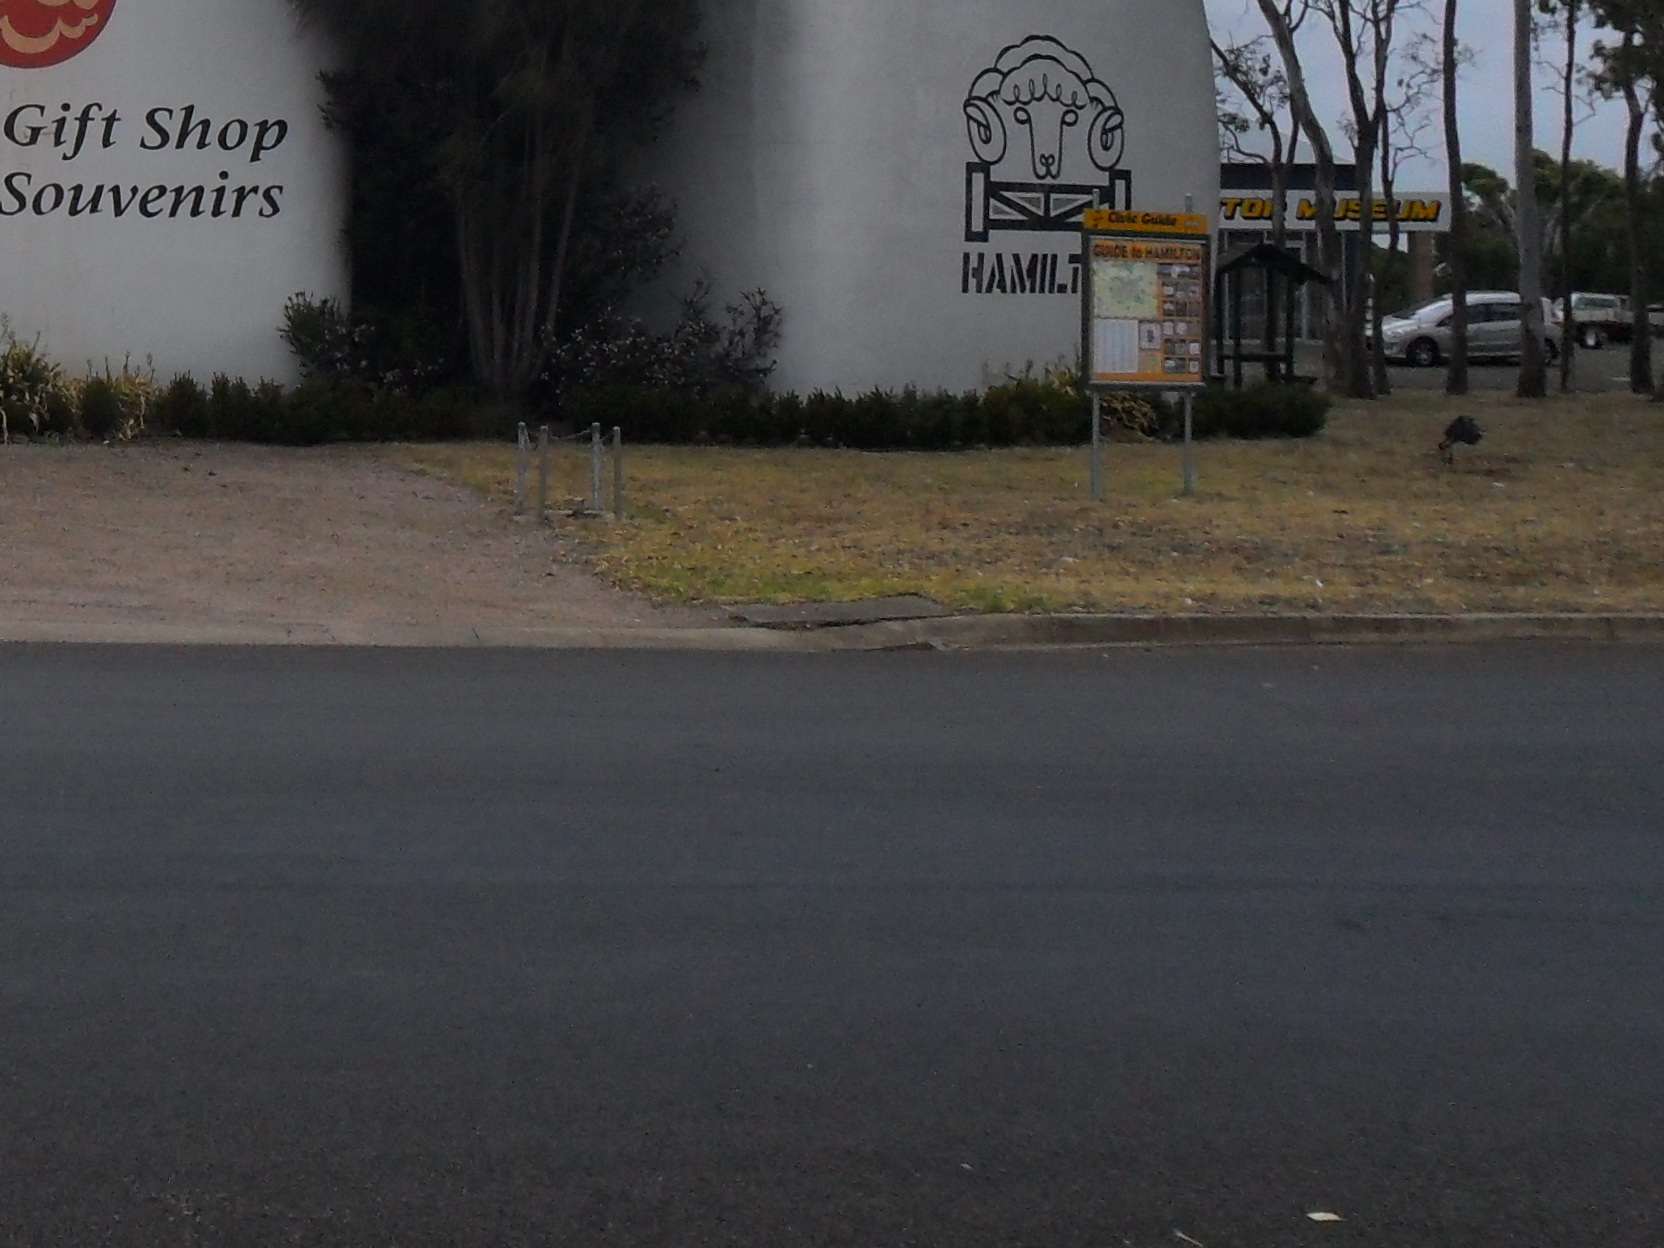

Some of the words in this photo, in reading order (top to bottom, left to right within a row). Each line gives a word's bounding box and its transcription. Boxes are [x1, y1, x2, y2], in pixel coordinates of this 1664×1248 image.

[3, 102, 122, 162] Gift
[139, 104, 289, 164] Shop
[961, 252, 1082, 294] HAMILT
